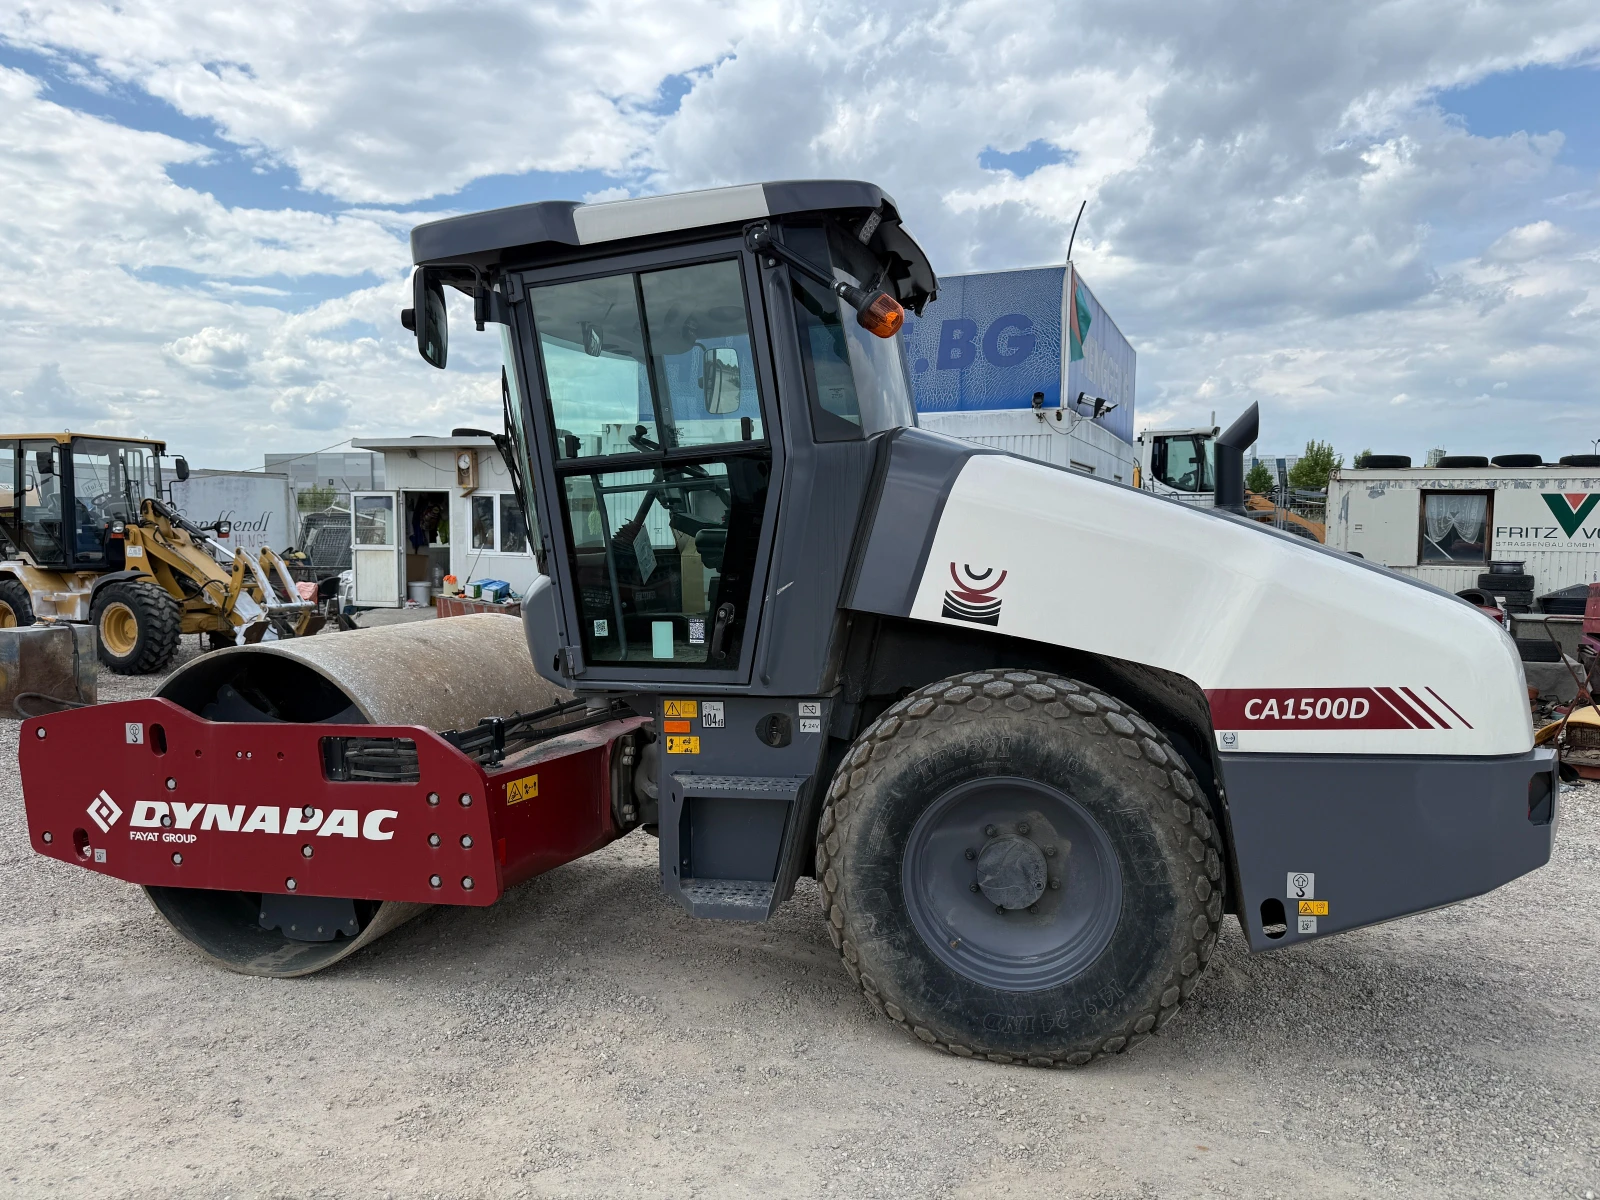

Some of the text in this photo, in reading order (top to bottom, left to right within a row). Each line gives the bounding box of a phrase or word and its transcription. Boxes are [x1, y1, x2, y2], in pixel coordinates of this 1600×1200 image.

[1496, 527, 1600, 539] FRITZ V
[1244, 696, 1370, 721] CA1500D
[703, 713, 717, 726] 104
[129, 800, 399, 841] DYNAPAC
[129, 831, 198, 844] FAYAT GROUP
[982, 1012, 1035, 1035] IND
